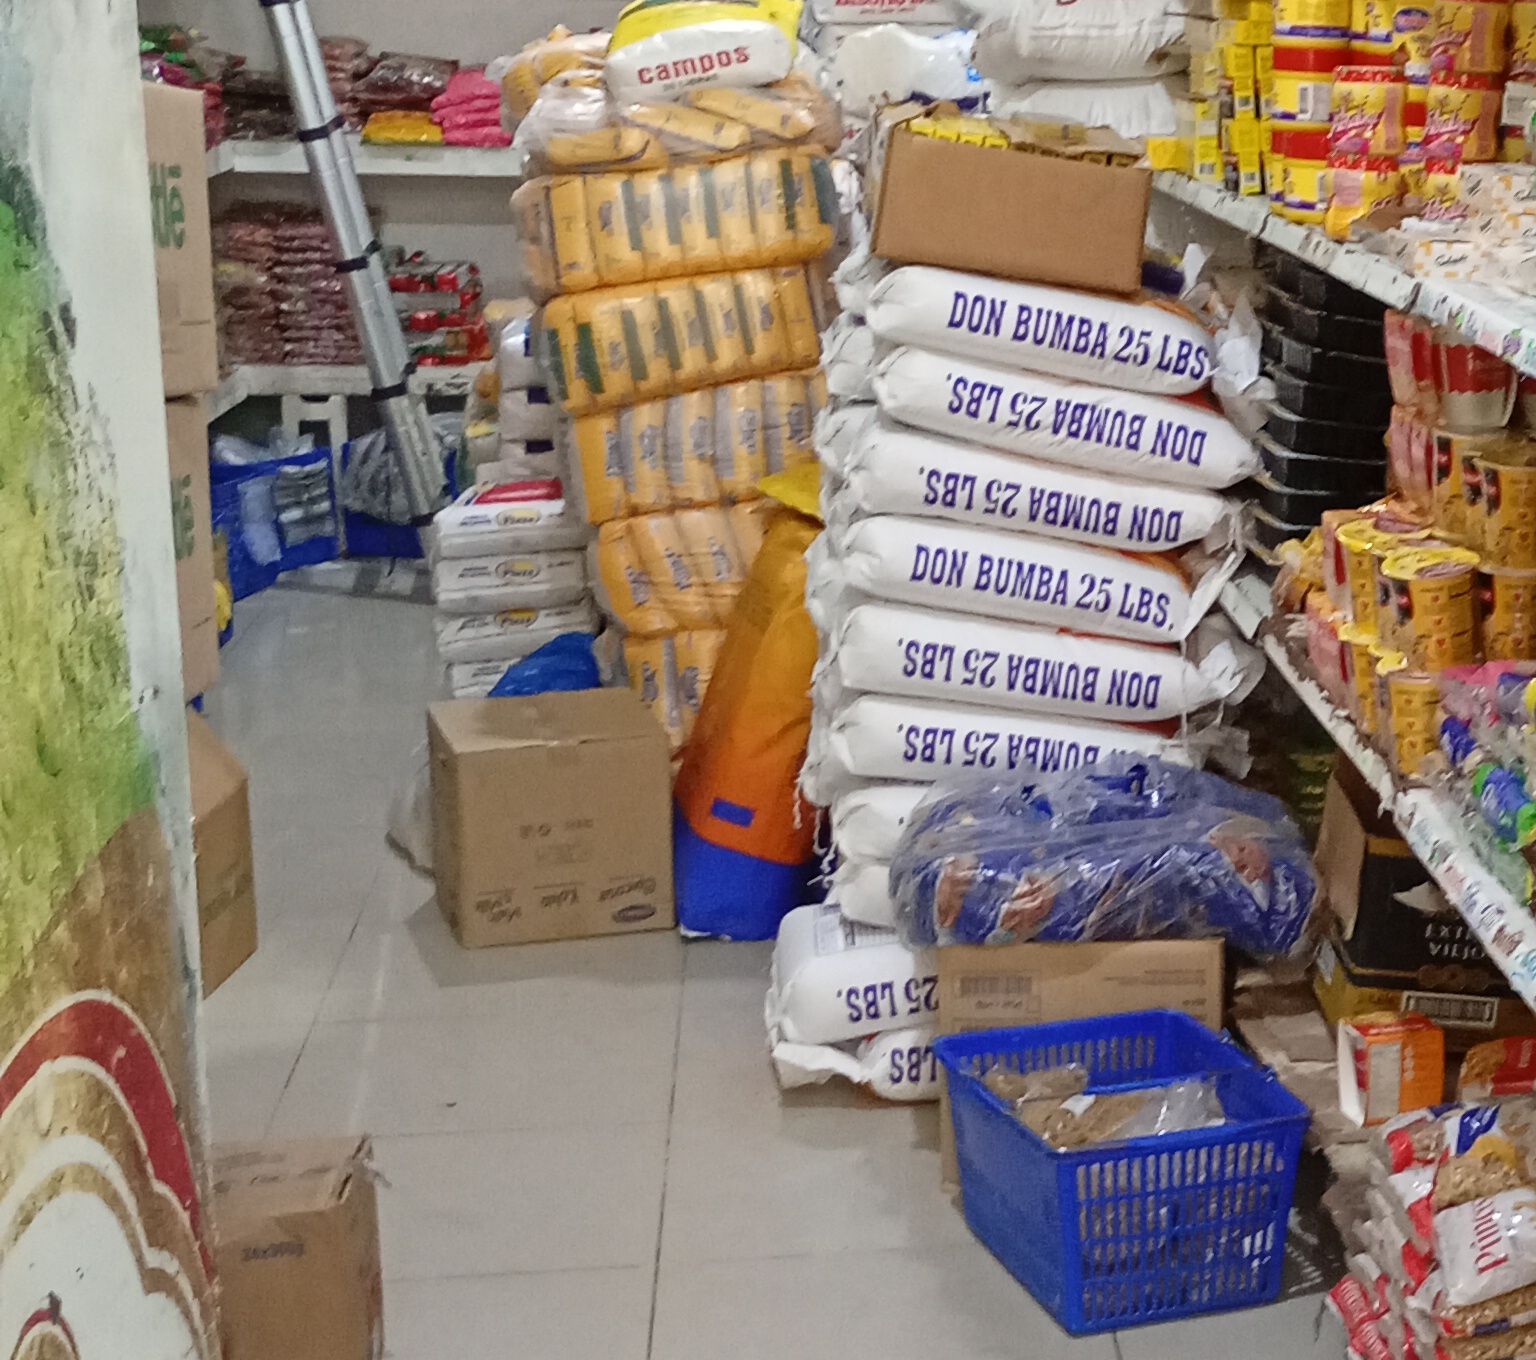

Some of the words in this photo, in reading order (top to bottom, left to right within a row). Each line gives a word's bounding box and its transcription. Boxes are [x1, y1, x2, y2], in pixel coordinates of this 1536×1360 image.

[637, 45, 751, 85] campos
[947, 290, 1007, 332] DON
[1012, 303, 1110, 359] BUMBA
[1111, 324, 1154, 366] 25
[945, 371, 1003, 422] LBS.
[1007, 390, 1048, 433] 25
[1051, 397, 1146, 458] BUMBA
[1149, 424, 1209, 468] DON
[918, 465, 977, 512] LBS.
[983, 477, 1024, 519] 25
[1027, 484, 1122, 540] BUMBA
[1126, 507, 1184, 544] DON
[909, 543, 971, 588] DON
[973, 553, 1071, 610] BUMBA
[1075, 570, 1117, 614] 25
[1117, 581, 1176, 633] LBS.
[896, 636, 956, 681] LBS.
[959, 646, 1001, 689] 25
[1006, 653, 1102, 705] BUMBA
[1106, 670, 1162, 710] DON
[896, 722, 956, 766] LBS.
[959, 729, 1001, 770] 25
[835, 975, 899, 1025] LBS.
